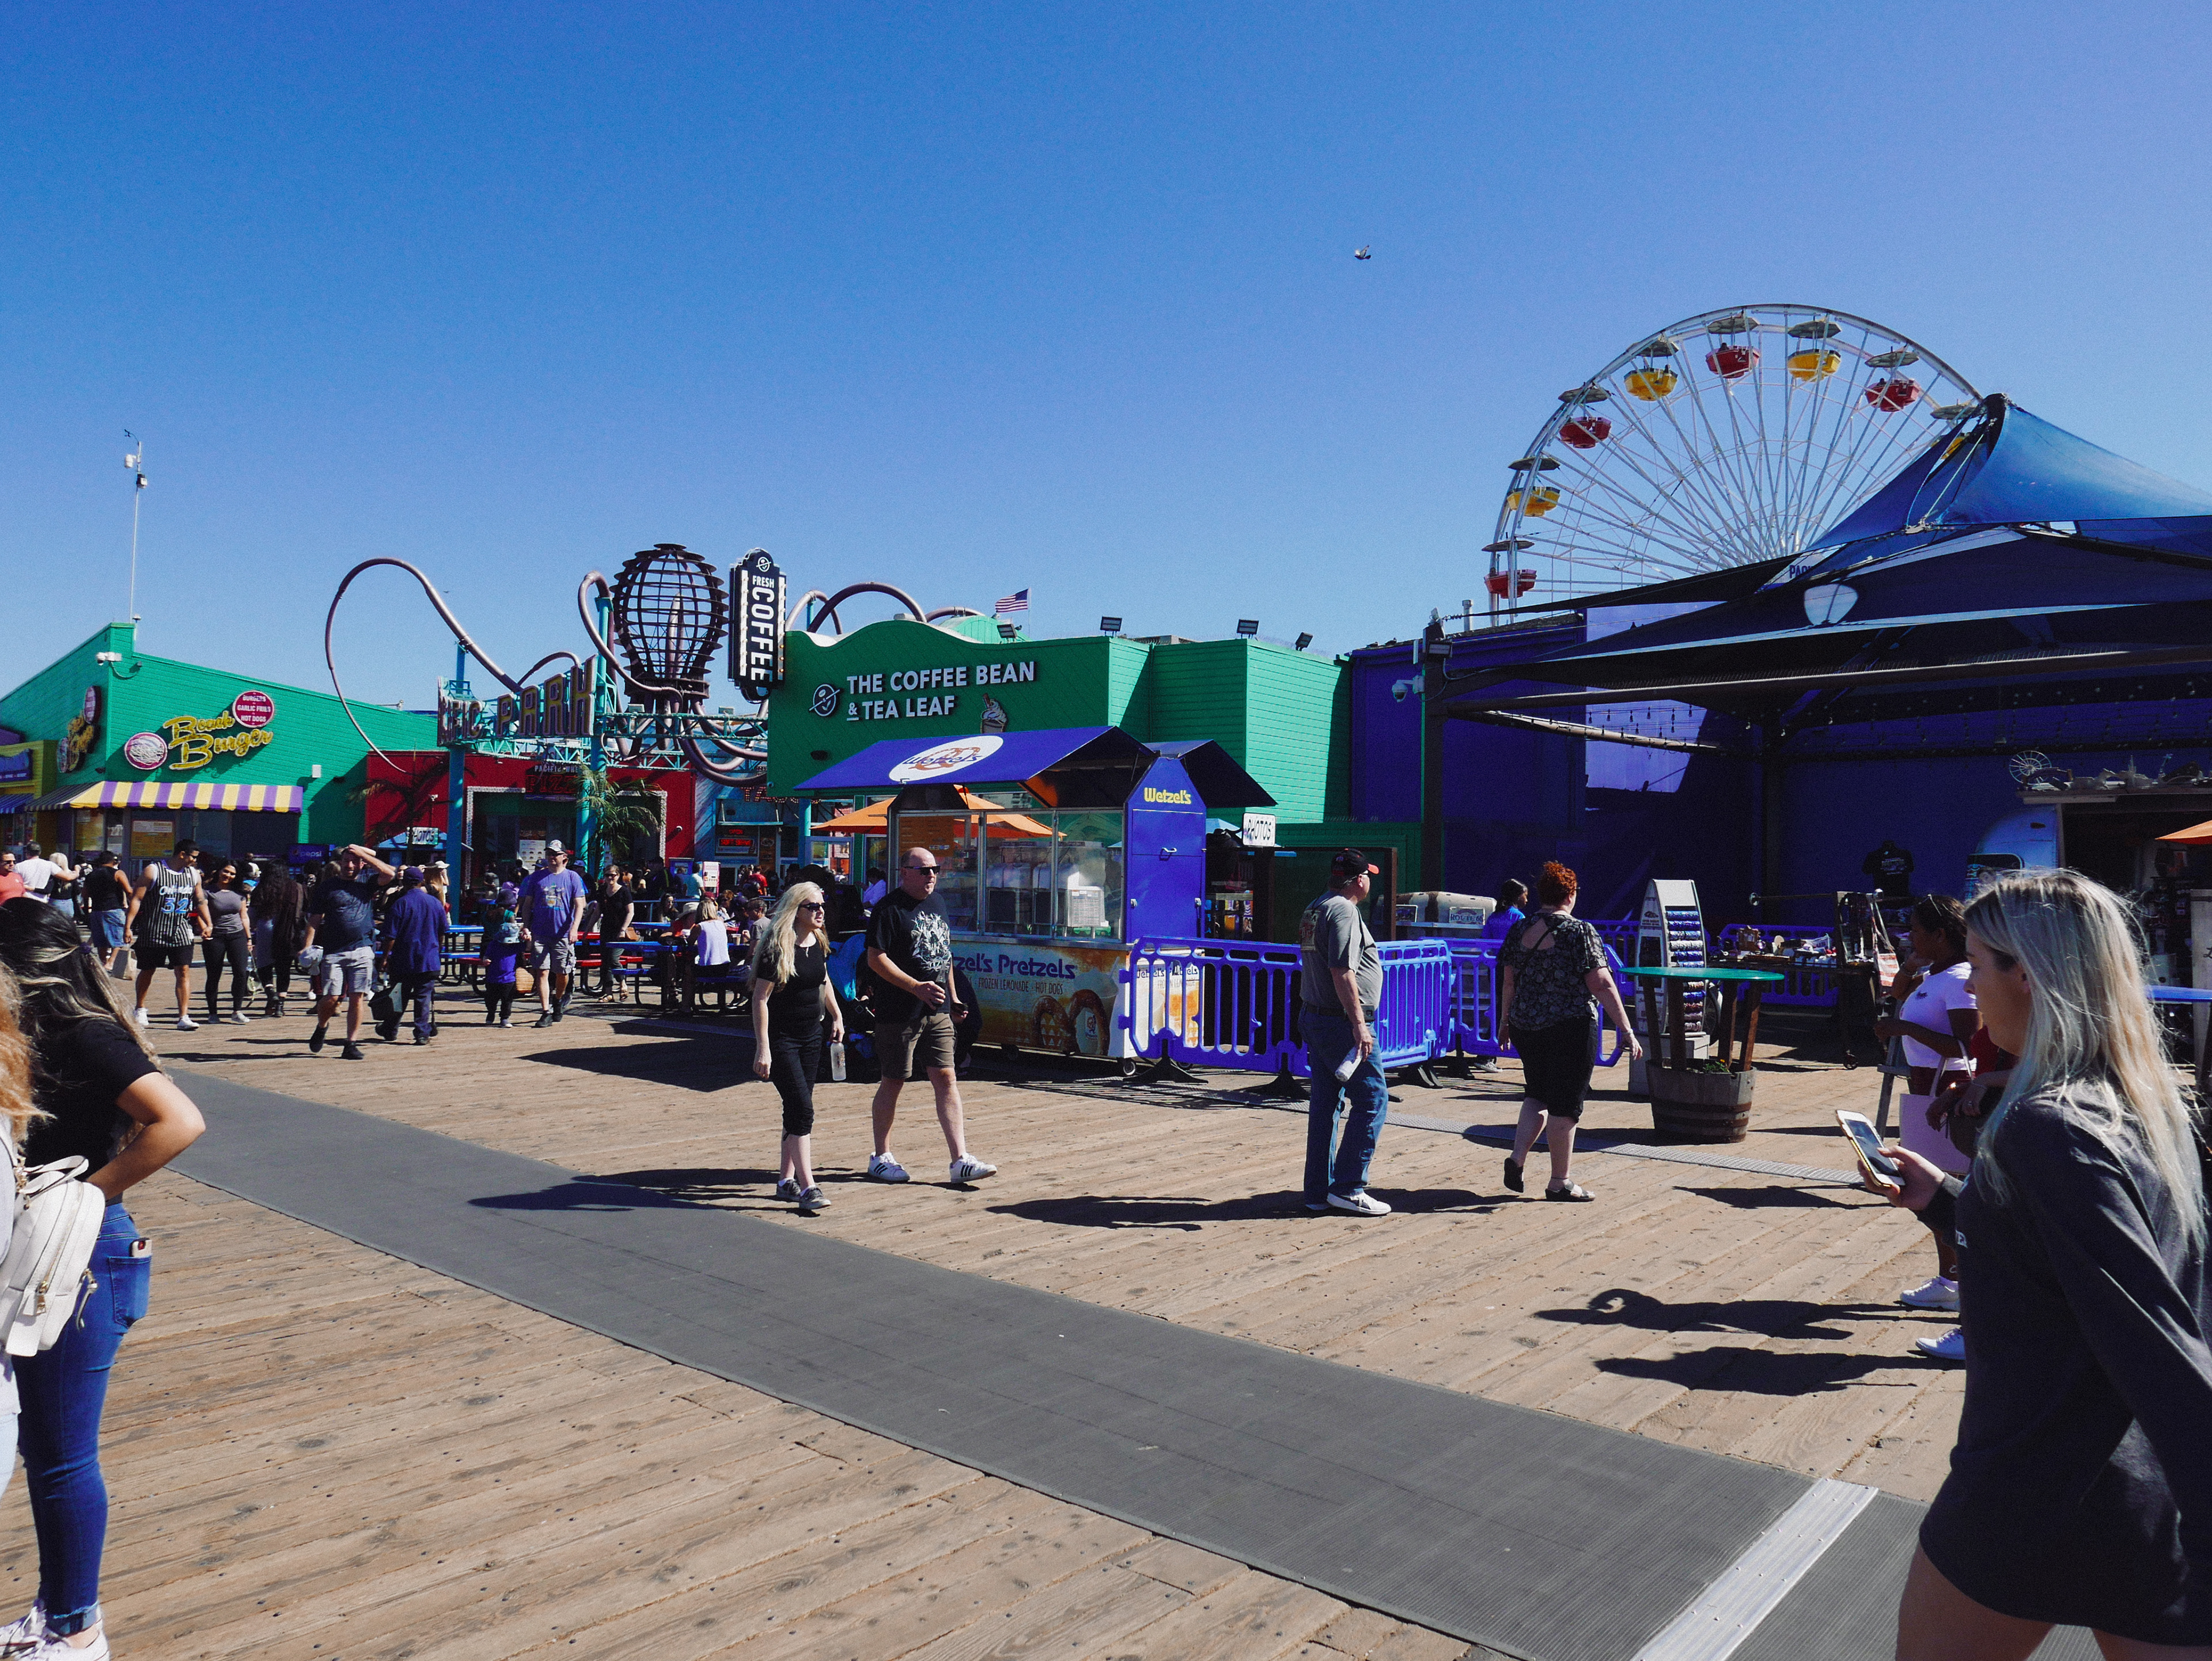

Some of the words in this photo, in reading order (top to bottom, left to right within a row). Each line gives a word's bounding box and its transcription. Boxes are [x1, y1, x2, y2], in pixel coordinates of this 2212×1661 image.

[752, 575, 775, 589] FRESH
[751, 586, 775, 682] COFFEE
[846, 673, 883, 695] THE
[890, 666, 967, 691] COFFEE
[976, 661, 1035, 685] BEAN
[497, 653, 597, 737] PARK
[862, 699, 899, 720] TEA
[906, 695, 955, 718] LEAF
[163, 710, 236, 740] Beach
[168, 728, 274, 770] Burger
[525, 775, 578, 794] PIZZ
[1144, 787, 1192, 805] Wetzel's
[412, 829, 435, 843] HOTOS
[1247, 818, 1271, 841] PHOTOS
[161, 897, 189, 914] 32
[1450, 913, 1474, 921] ROUTE
[951, 952, 993, 973] zel's
[998, 954, 1076, 980] Pretzels
[978, 977, 998, 990] FROZEN
[999, 979, 1029, 993] LEMONADE
[1036, 981, 1047, 994] HOT
[1048, 983, 1064, 995] DOGS
